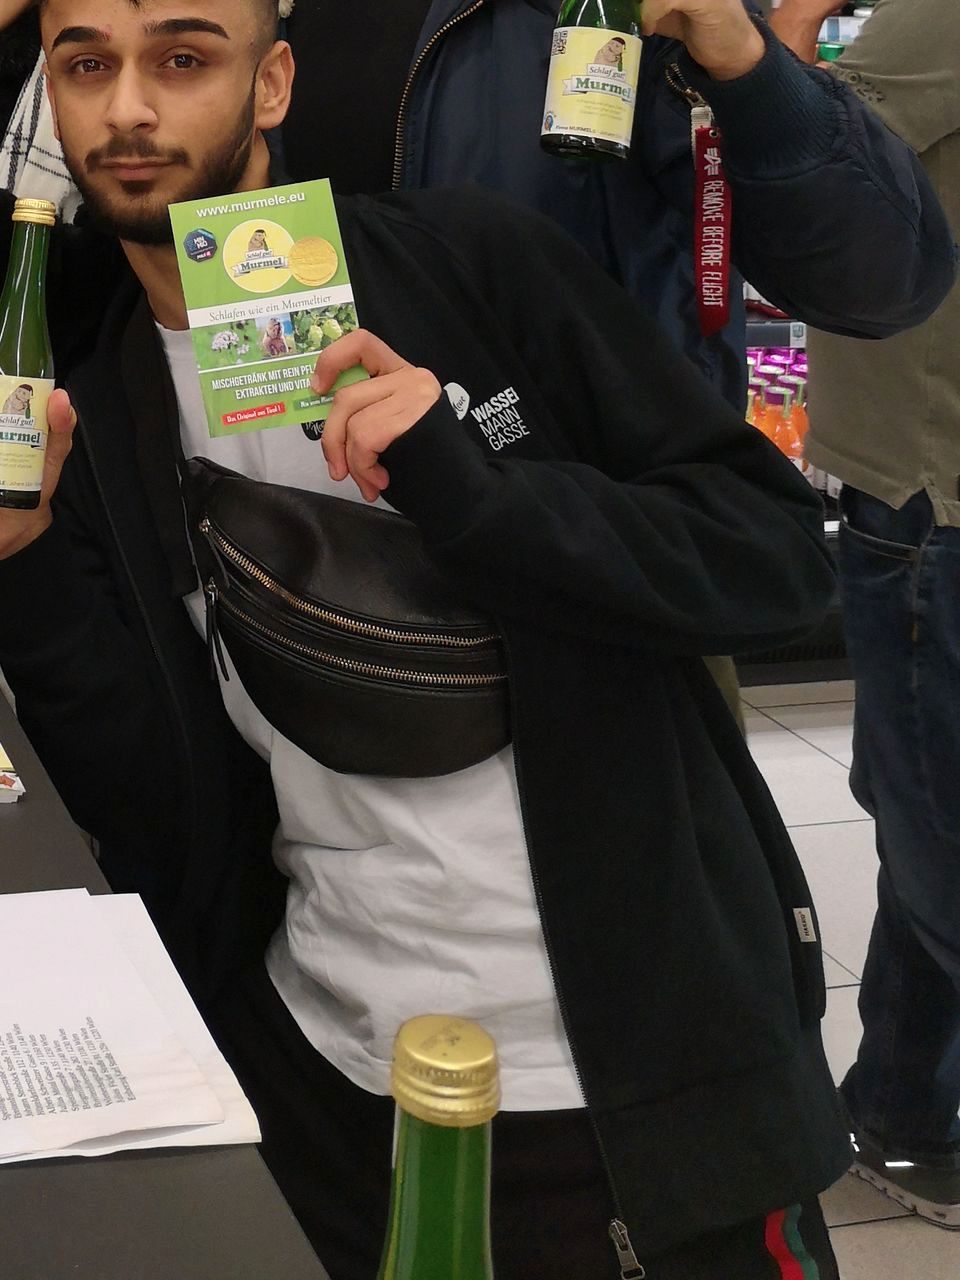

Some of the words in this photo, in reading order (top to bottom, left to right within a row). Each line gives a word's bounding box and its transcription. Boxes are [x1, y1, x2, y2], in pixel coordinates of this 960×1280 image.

[575, 77, 631, 99] Murmel
[196, 192, 305, 218] www.murmele.eu
[702, 180, 724, 222] REMOVE
[701, 226, 724, 267] BEFORE
[241, 258, 283, 271] Murmel
[701, 271, 723, 307] FLIGHT
[209, 308, 246, 322] Schlafen
[248, 305, 264, 316] wie
[266, 303, 280, 312] ein
[282, 295, 332, 311] Murmeltier
[212, 375, 268, 391] MISCHGETRÄNK
[268, 371, 282, 381] MIT
[283, 367, 299, 379] REIN
[236, 386, 279, 400] EXTRAKTEN
[279, 382, 294, 392] UND
[294, 377, 311, 389] VITA
[479, 406, 521, 438] MANN
[489, 420, 531, 451] GASSE
[6, 1032, 15, 1044] Wien
[3, 1056, 15, 1071] Straße
